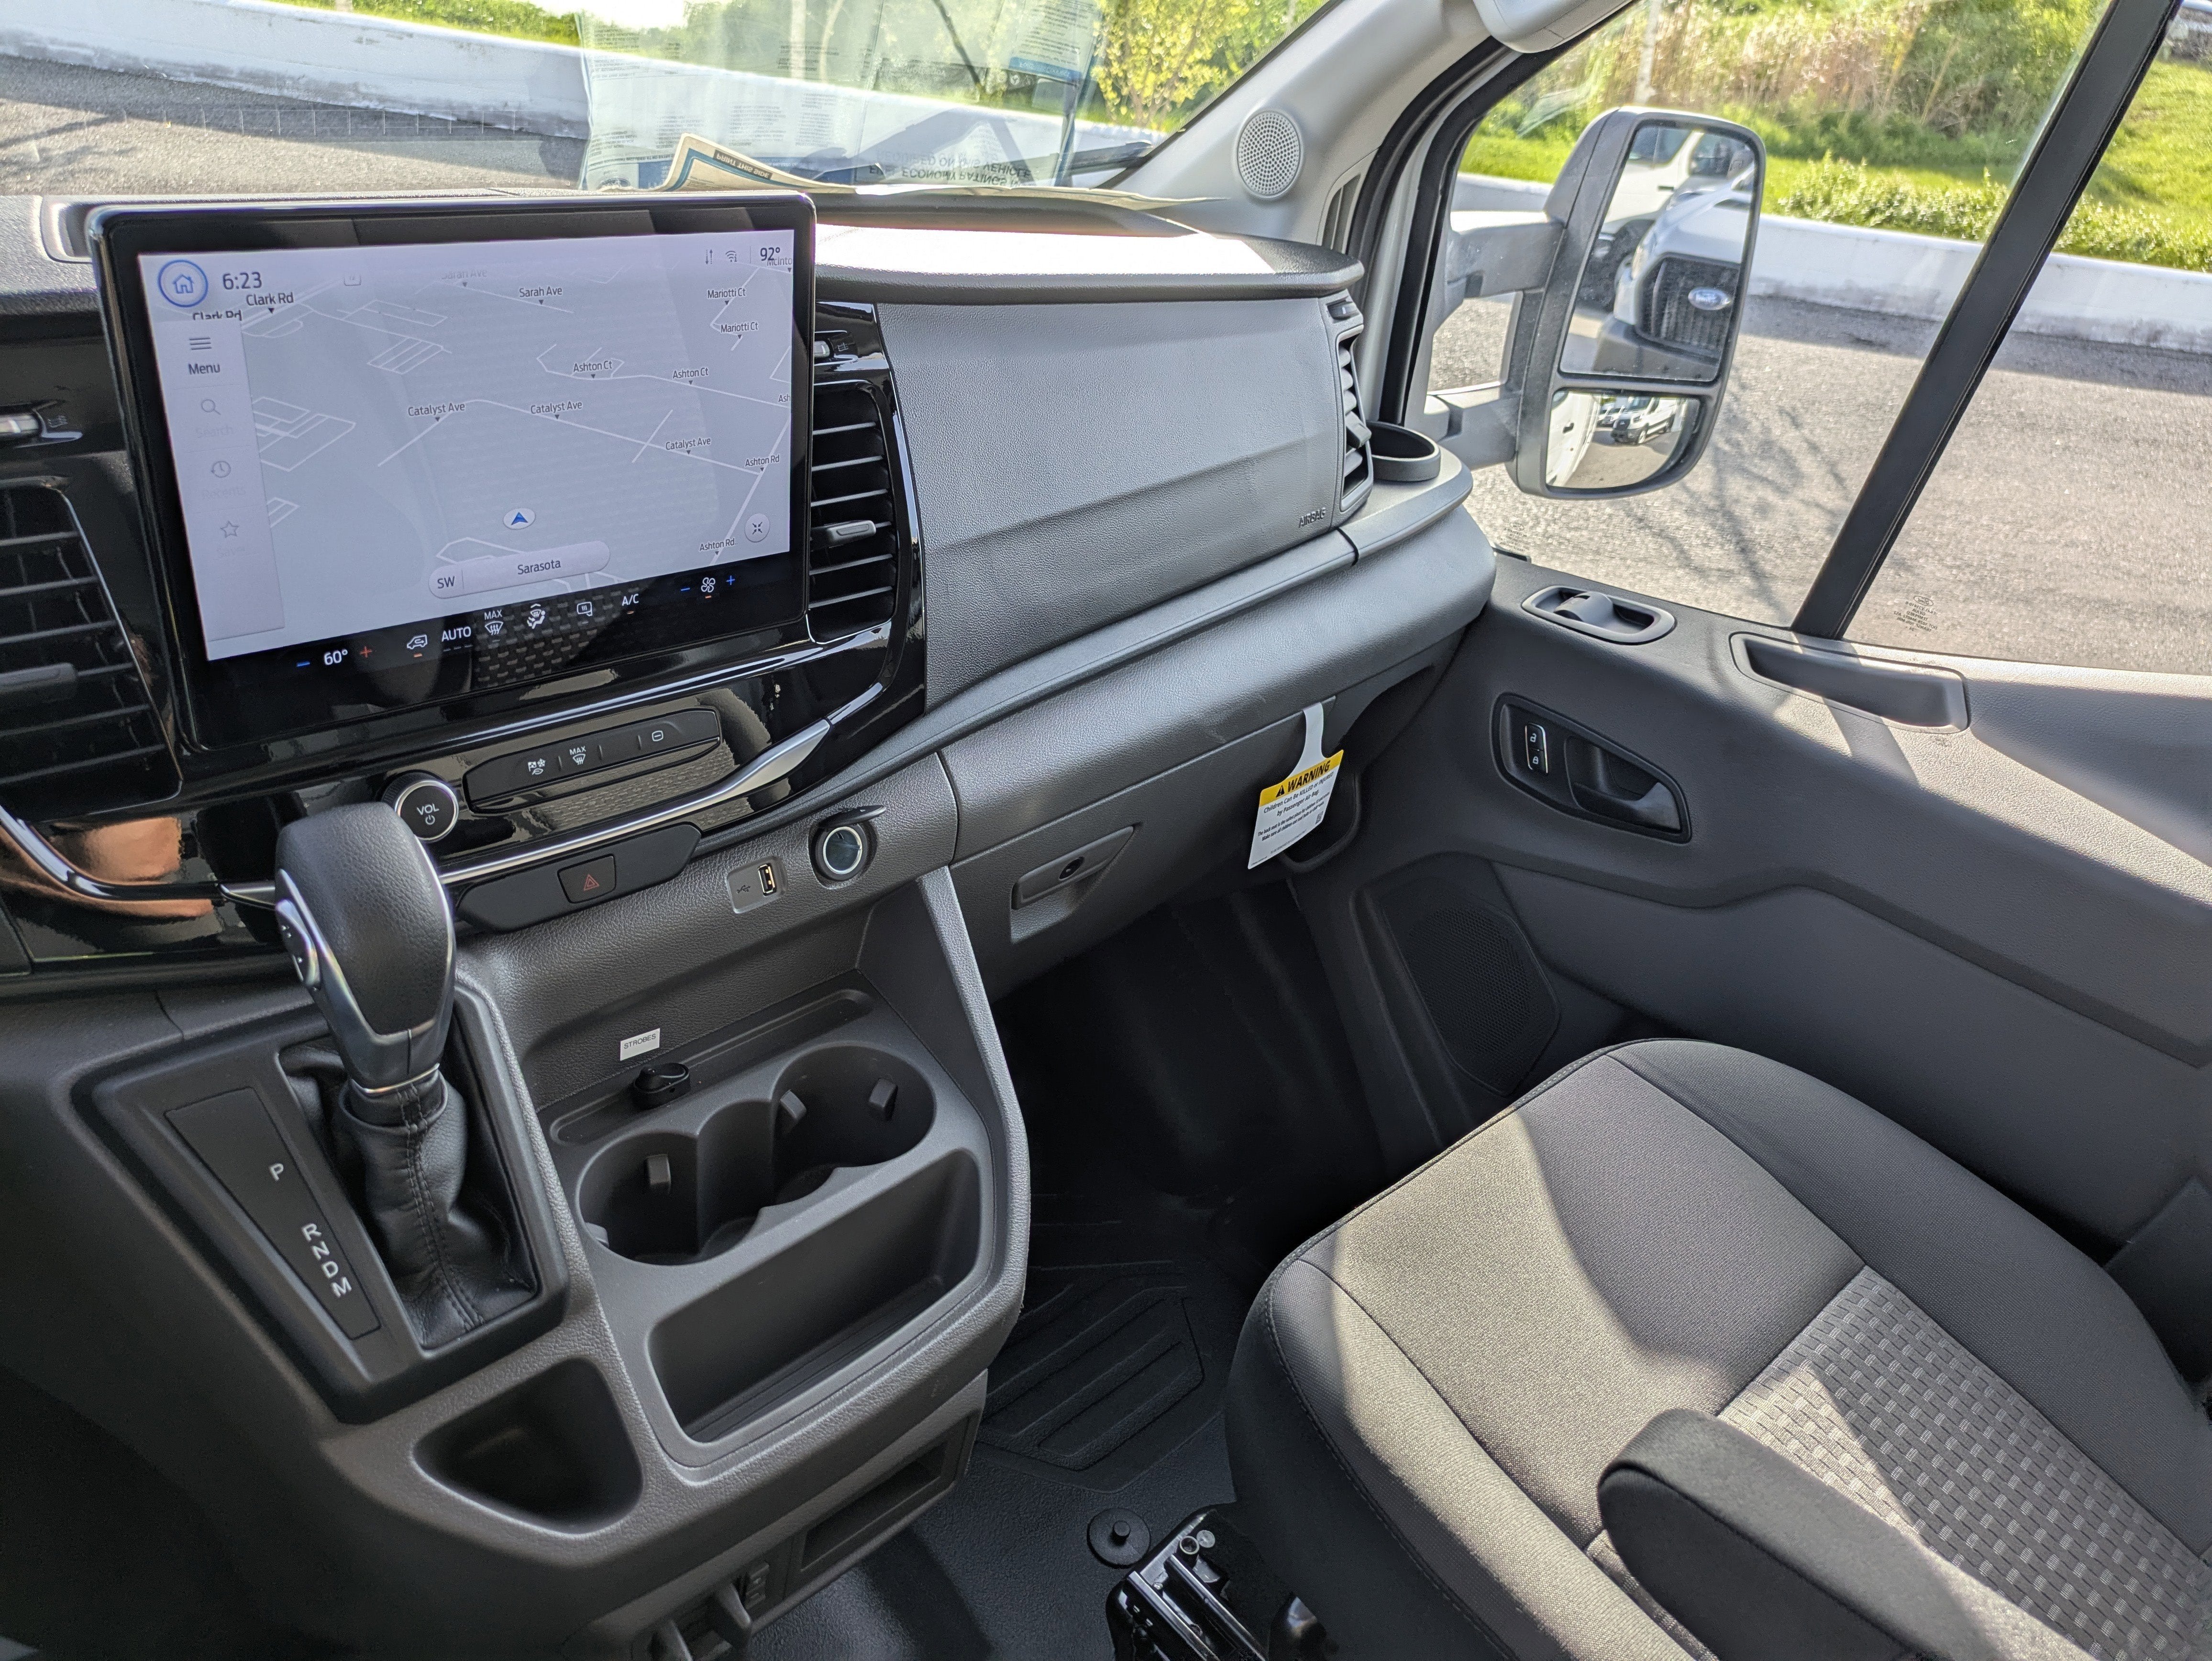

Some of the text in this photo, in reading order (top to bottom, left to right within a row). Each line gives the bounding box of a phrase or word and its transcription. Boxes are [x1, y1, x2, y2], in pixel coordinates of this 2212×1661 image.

[222, 272, 262, 289] 6:23
[246, 292, 294, 306] Clark Rd
[519, 287, 563, 297] Sarah Ave
[707, 288, 746, 299] Mariotti Ct
[721, 321, 758, 333] Mariotti Ct
[188, 363, 220, 375] Menu
[574, 360, 612, 372] Ashton Ct
[673, 367, 708, 379] Ashton Ct
[408, 402, 465, 417] Catalyst Ave
[531, 401, 582, 415] Catalyst Ave
[665, 437, 711, 451] Catalyst Ave
[745, 454, 780, 467] Ashton Rd
[1298, 507, 1326, 528] AIRBAG
[699, 538, 735, 552] Ashton Rd
[437, 558, 561, 589] SW Sarasota
[622, 594, 639, 606] A/C
[484, 610, 503, 620] MAX
[441, 626, 472, 642] AUTO
[1288, 760, 1331, 792] WARNING
[1263, 801, 1283, 813] Children
[1299, 785, 1313, 796] KILLED
[1283, 798, 1305, 811] Passenger
[417, 803, 440, 816] VOL
[623, 1033, 656, 1049] STROBES
[269, 1163, 284, 1181] P
[301, 1223, 321, 1241] R
[310, 1241, 330, 1260] N
[321, 1261, 339, 1278] D
[332, 1277, 352, 1298] M
